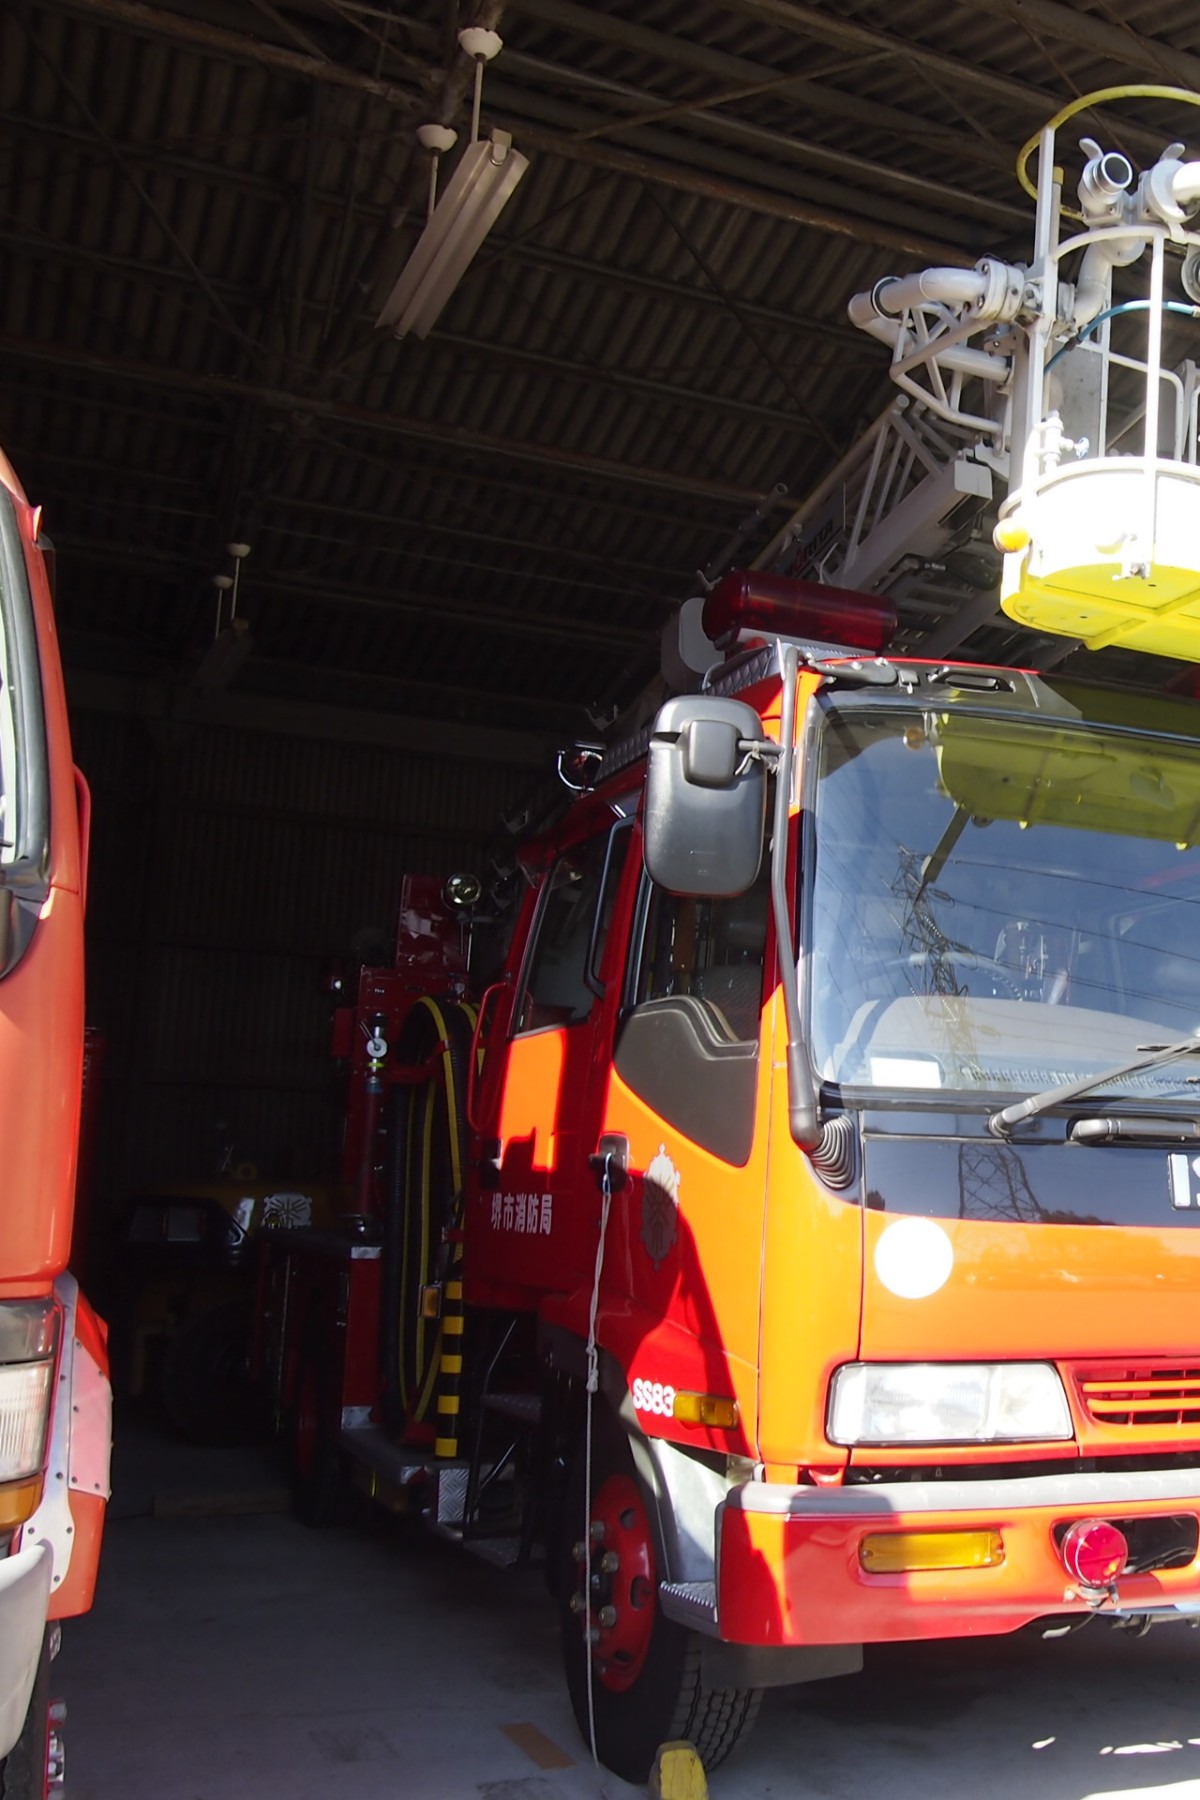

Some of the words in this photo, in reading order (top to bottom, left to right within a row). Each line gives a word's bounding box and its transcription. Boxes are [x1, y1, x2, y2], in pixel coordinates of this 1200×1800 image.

[491, 1192, 553, 1235] 堺市消防局
[633, 1377, 675, 1418] SS83
